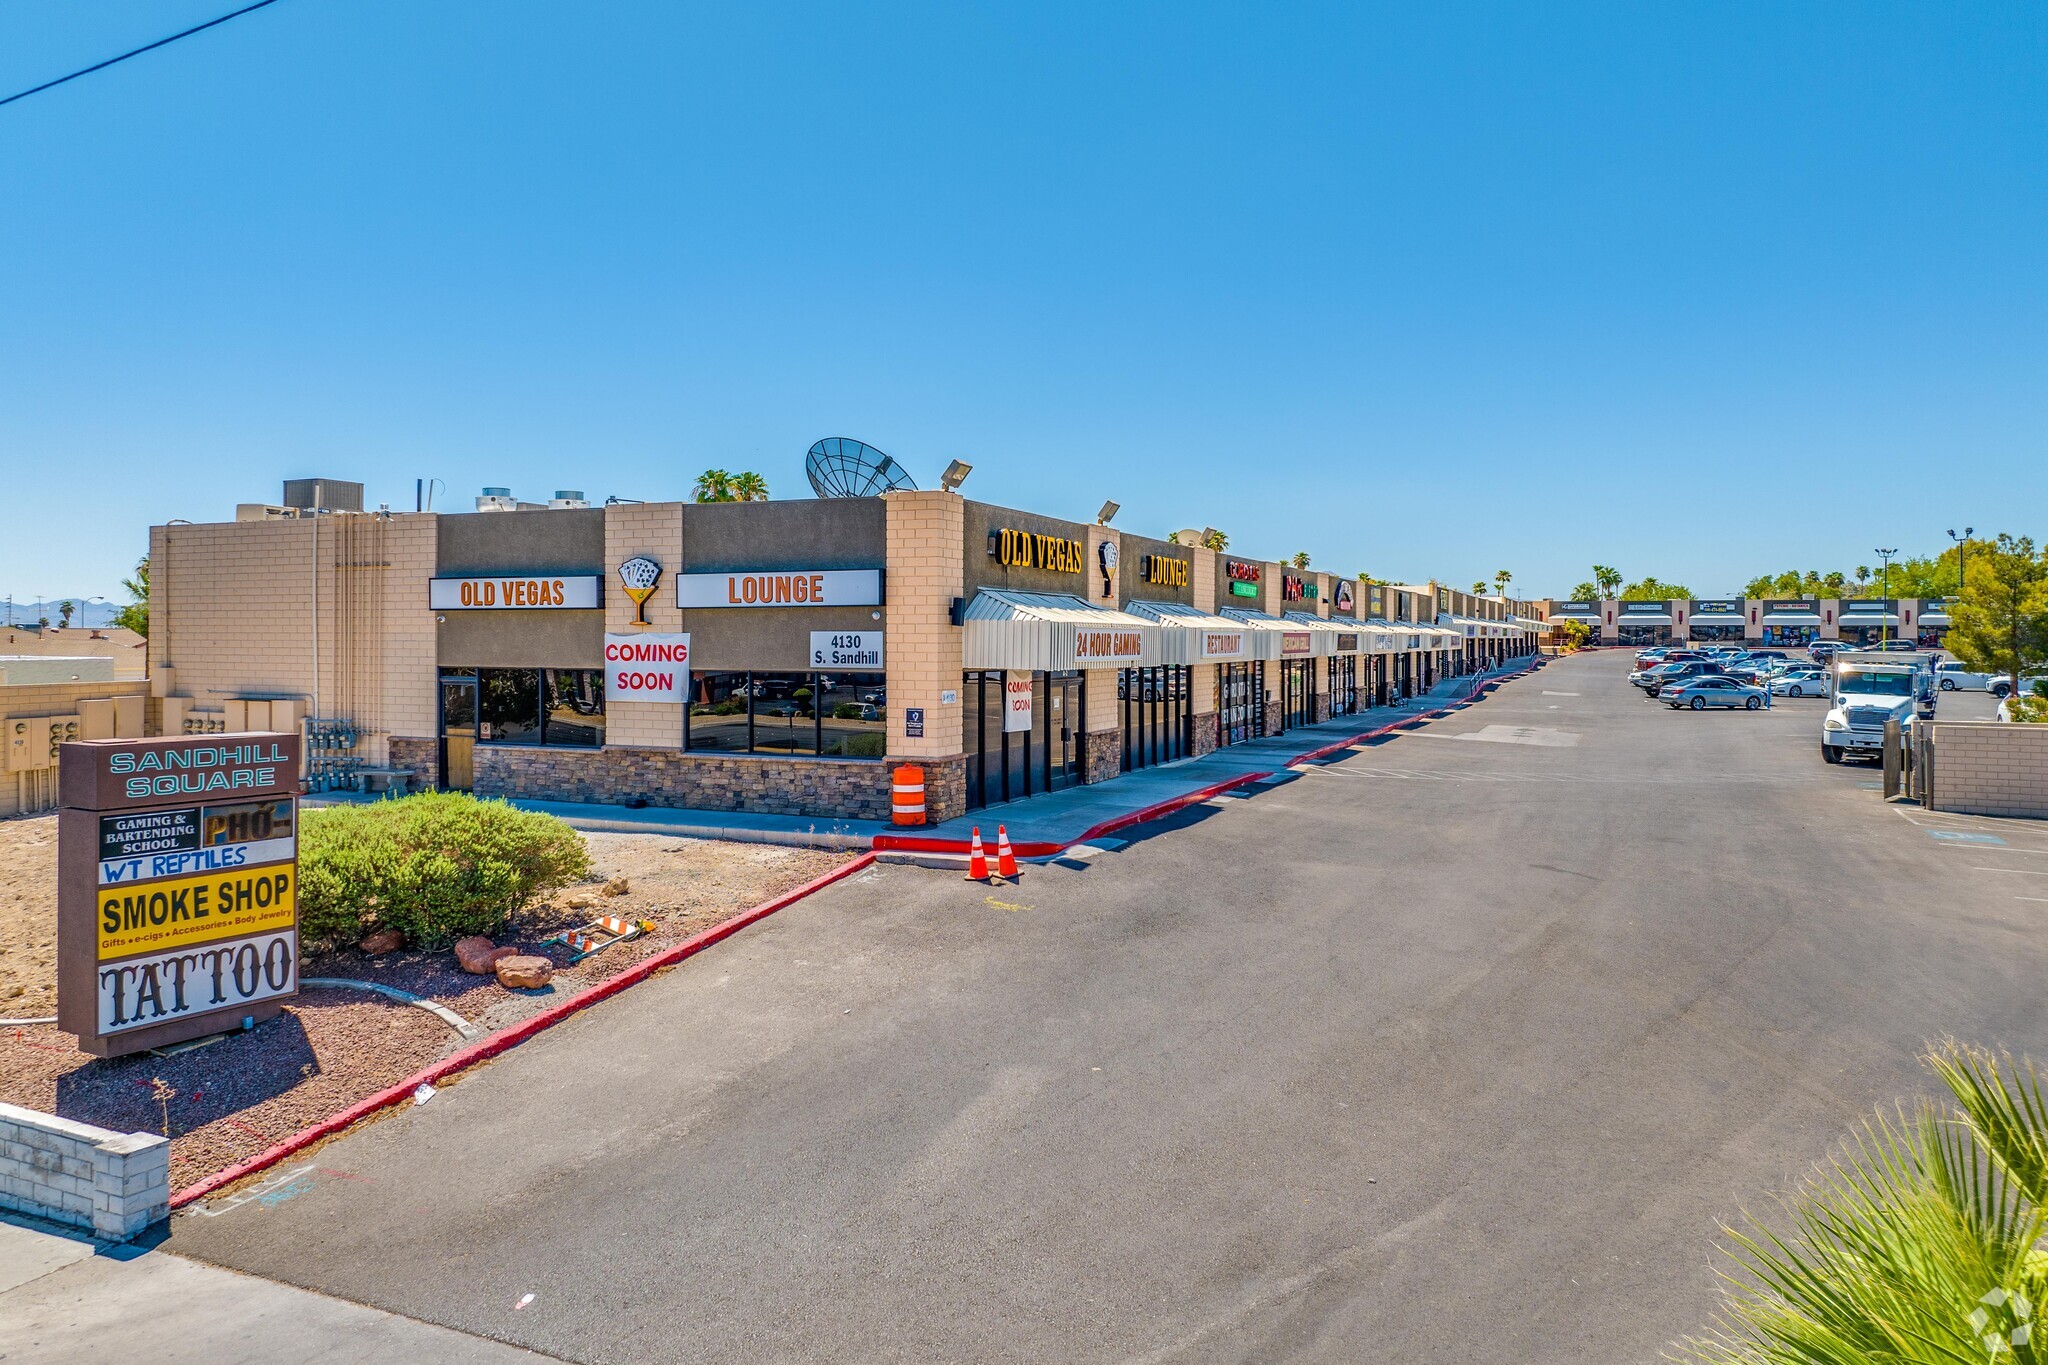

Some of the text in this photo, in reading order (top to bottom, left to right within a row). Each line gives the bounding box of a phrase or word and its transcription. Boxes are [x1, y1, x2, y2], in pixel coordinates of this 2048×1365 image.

[1001, 528, 1082, 574] OLD VEGAS
[1150, 555, 1188, 587] LOUNGE
[460, 580, 564, 607] OLD VEGAS
[728, 574, 824, 604] LOUNGE
[605, 643, 687, 662] COMING
[831, 635, 861, 648] 4130
[1077, 632, 1141, 657] 24 HOUR GAMING
[1207, 634, 1241, 654] RESTAURANT
[815, 650, 878, 664] S. Sandhill
[617, 671, 673, 691] SOON
[1008, 680, 1032, 693] COMING
[110, 743, 288, 774] SANDHILL
[126, 767, 276, 798] SQUARE
[106, 825, 195, 843] BARTENDING
[116, 815, 186, 830] GAMING &
[122, 838, 179, 853] SCHOOL
[104, 846, 247, 882] WT REPTILES
[103, 873, 289, 934] SMOKE SHOP
[102, 908, 292, 949] Gifts e-cigs Accessories Body Jewelry
[100, 937, 292, 1027] TATTOO
